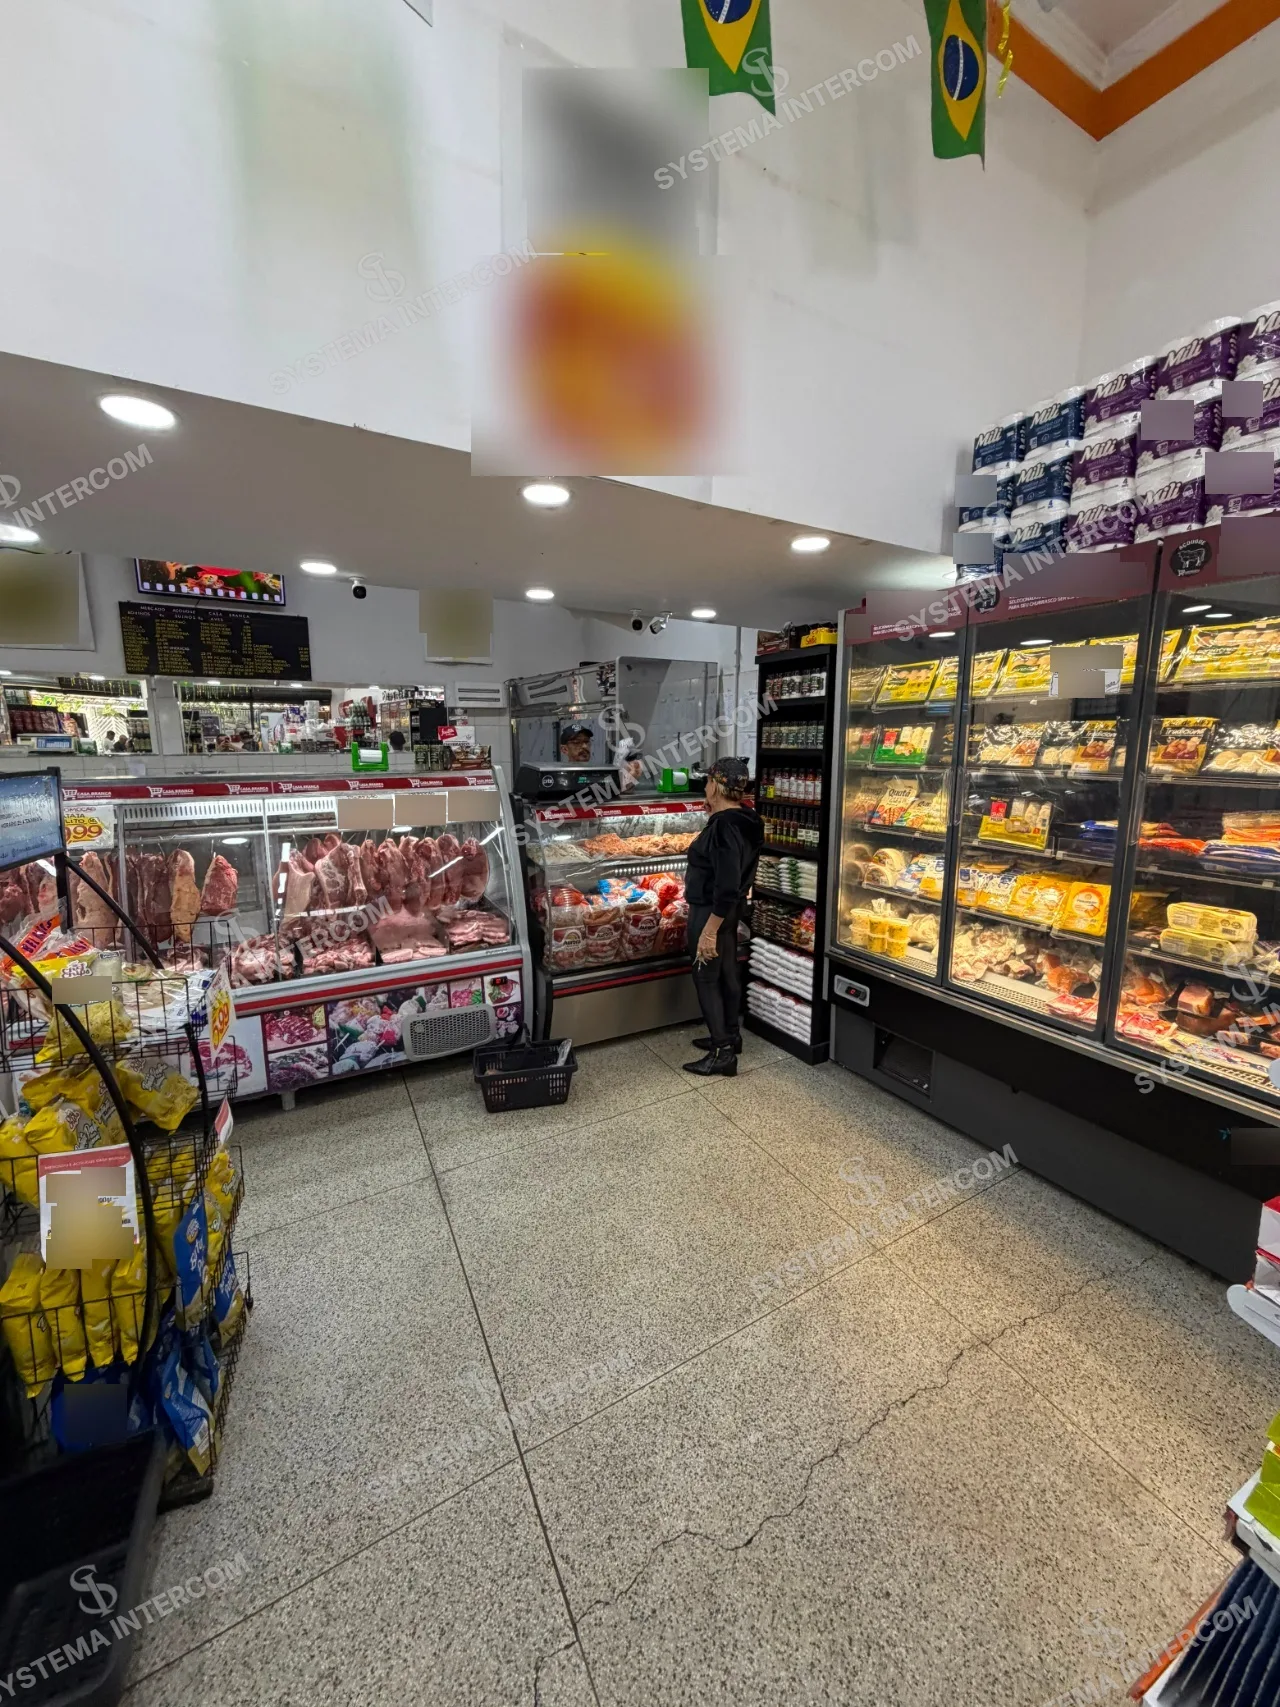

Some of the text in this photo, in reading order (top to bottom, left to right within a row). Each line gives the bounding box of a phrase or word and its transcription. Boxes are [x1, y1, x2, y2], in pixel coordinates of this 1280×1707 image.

[1162, 337, 1205, 372] Mili
[1091, 373, 1128, 403] Mili
[1030, 403, 1061, 429] Mili
[976, 427, 1003, 450] Mili
[1079, 438, 1117, 464] Mili
[1016, 462, 1046, 486] Mili
[1012, 522, 1043, 544] Mili
[889, 788, 911, 797] Quatá
